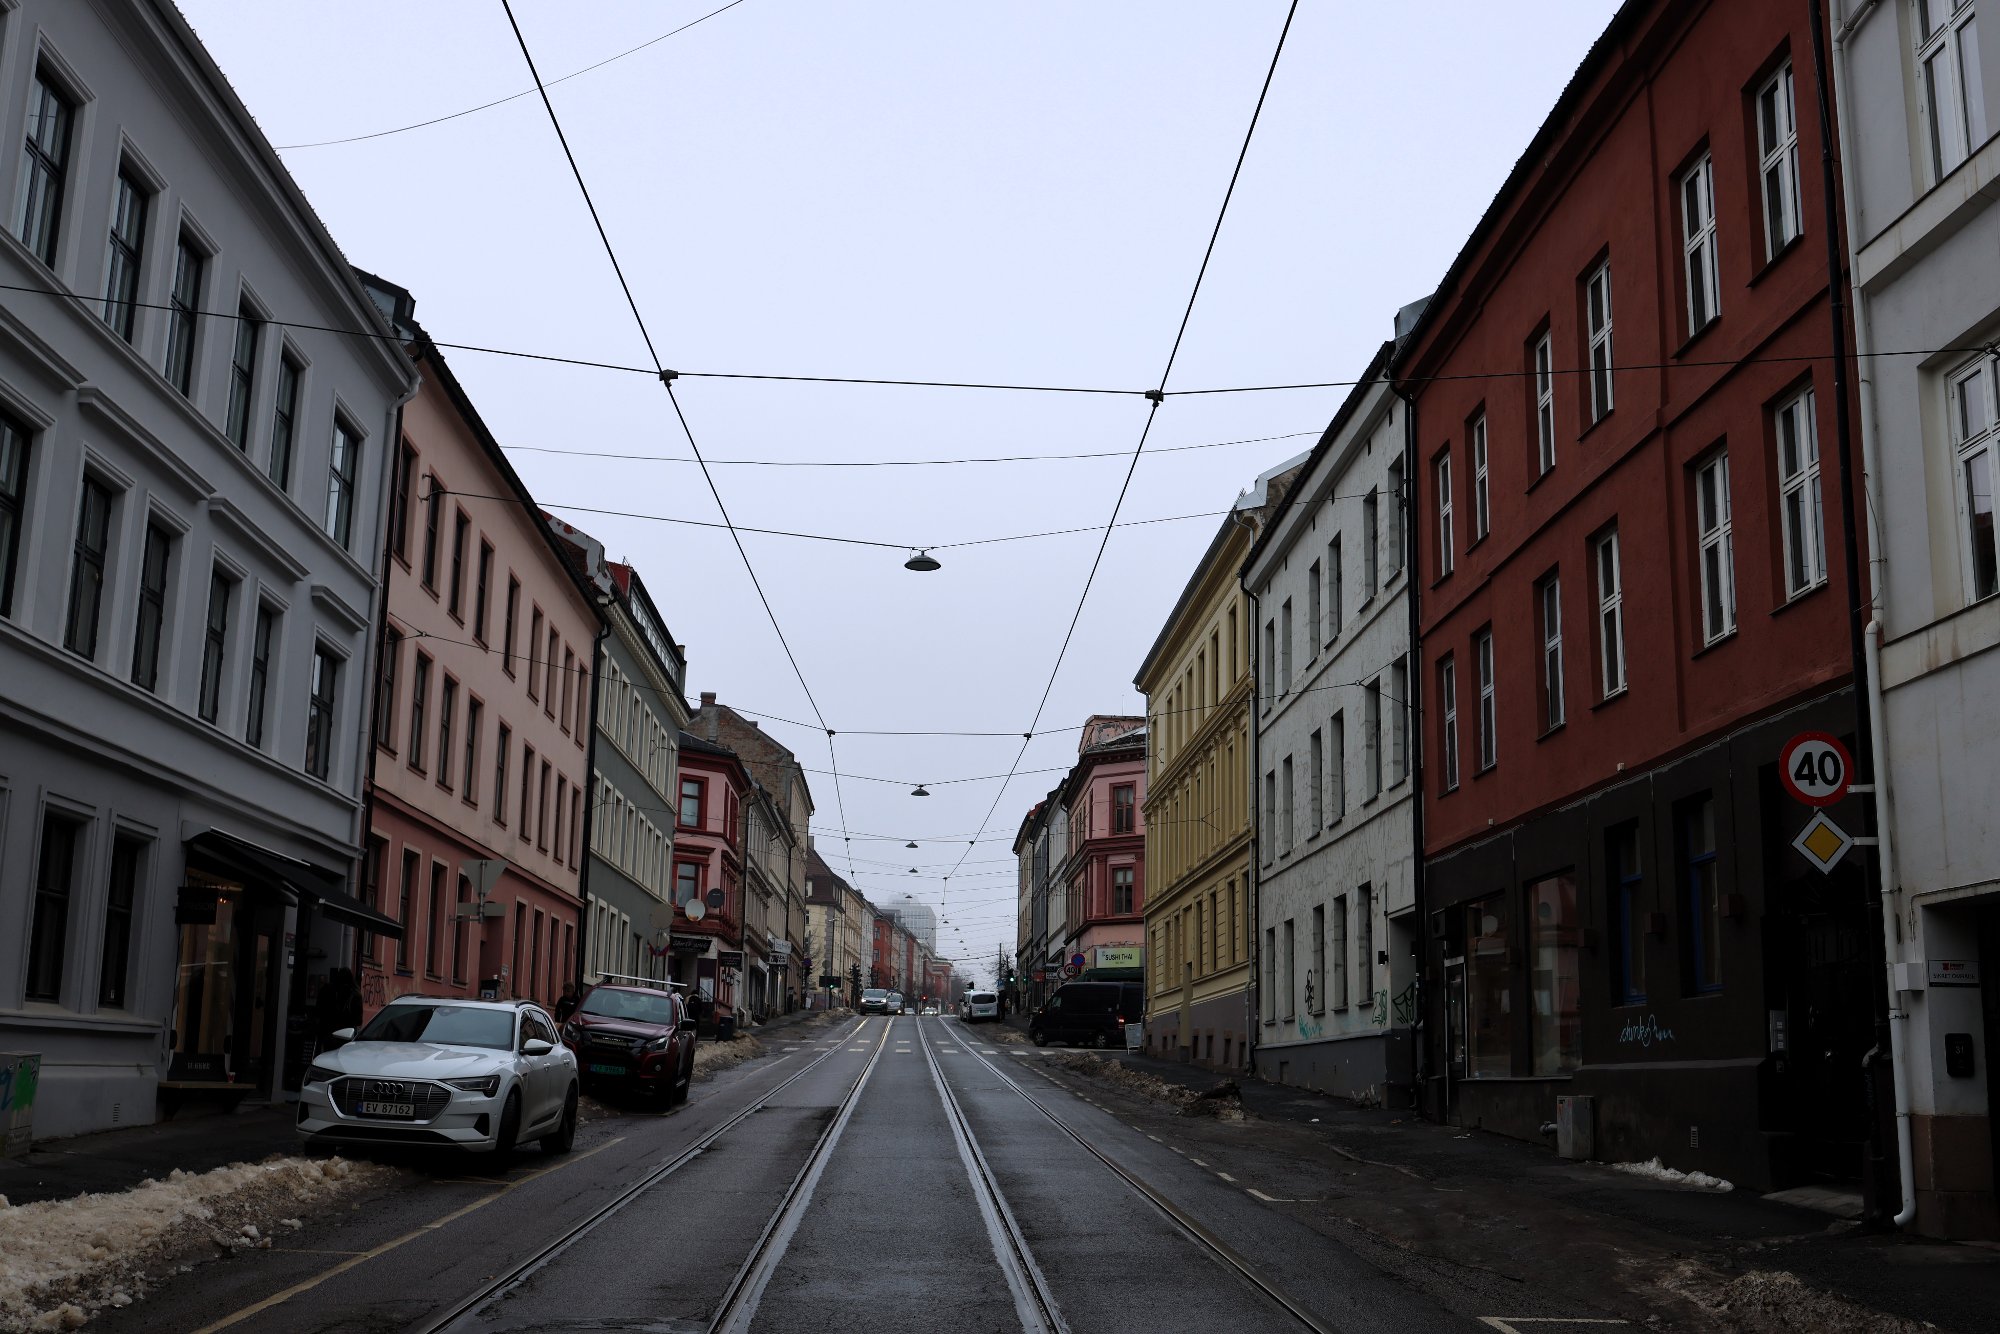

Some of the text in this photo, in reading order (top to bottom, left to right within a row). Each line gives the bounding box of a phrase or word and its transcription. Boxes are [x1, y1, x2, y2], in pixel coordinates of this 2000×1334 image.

[1794, 751, 1841, 786] 40
[1066, 966, 1075, 974] 40
[366, 1103, 410, 1115] EV 87162
